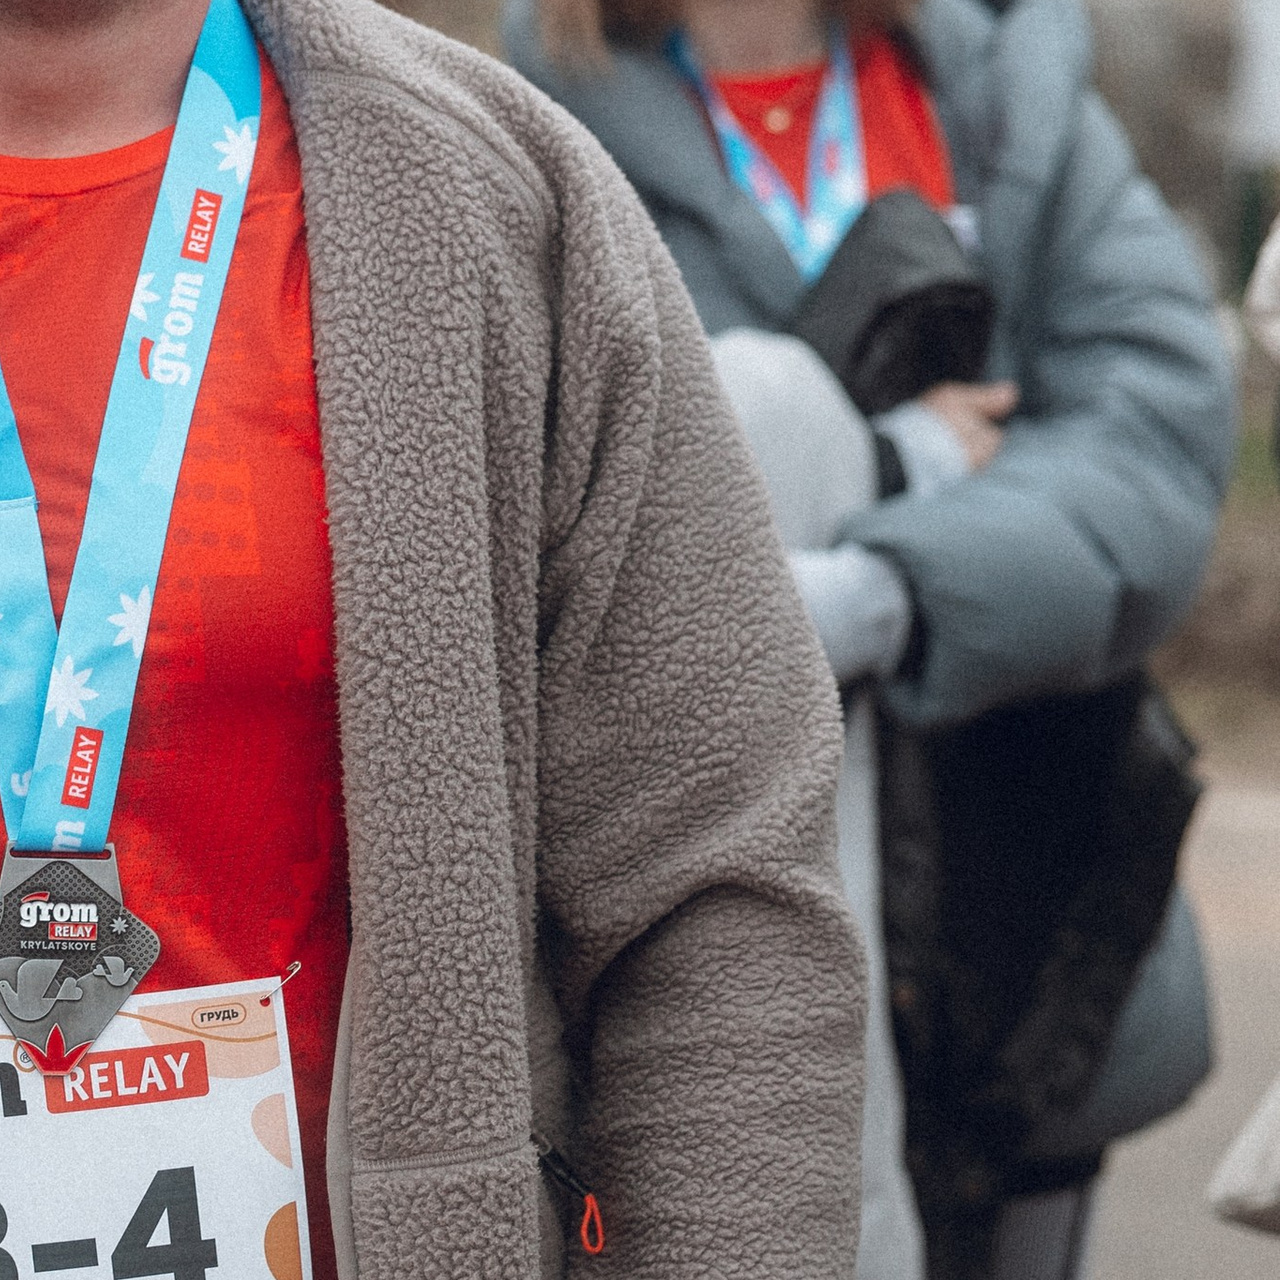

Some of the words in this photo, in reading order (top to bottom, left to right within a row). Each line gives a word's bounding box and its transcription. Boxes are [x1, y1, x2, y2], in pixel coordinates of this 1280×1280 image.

[152, 271, 205, 386] grom
[187, 196, 217, 254] RELAY
[68, 734, 97, 799] RELAY
[20, 901, 99, 928] grom
[54, 925, 94, 938] RELAY
[20, 940, 97, 951] KRYLATSKOYE
[200, 1008, 239, 1022] ГРУДЬ
[62, 1052, 190, 1103] RELAY
